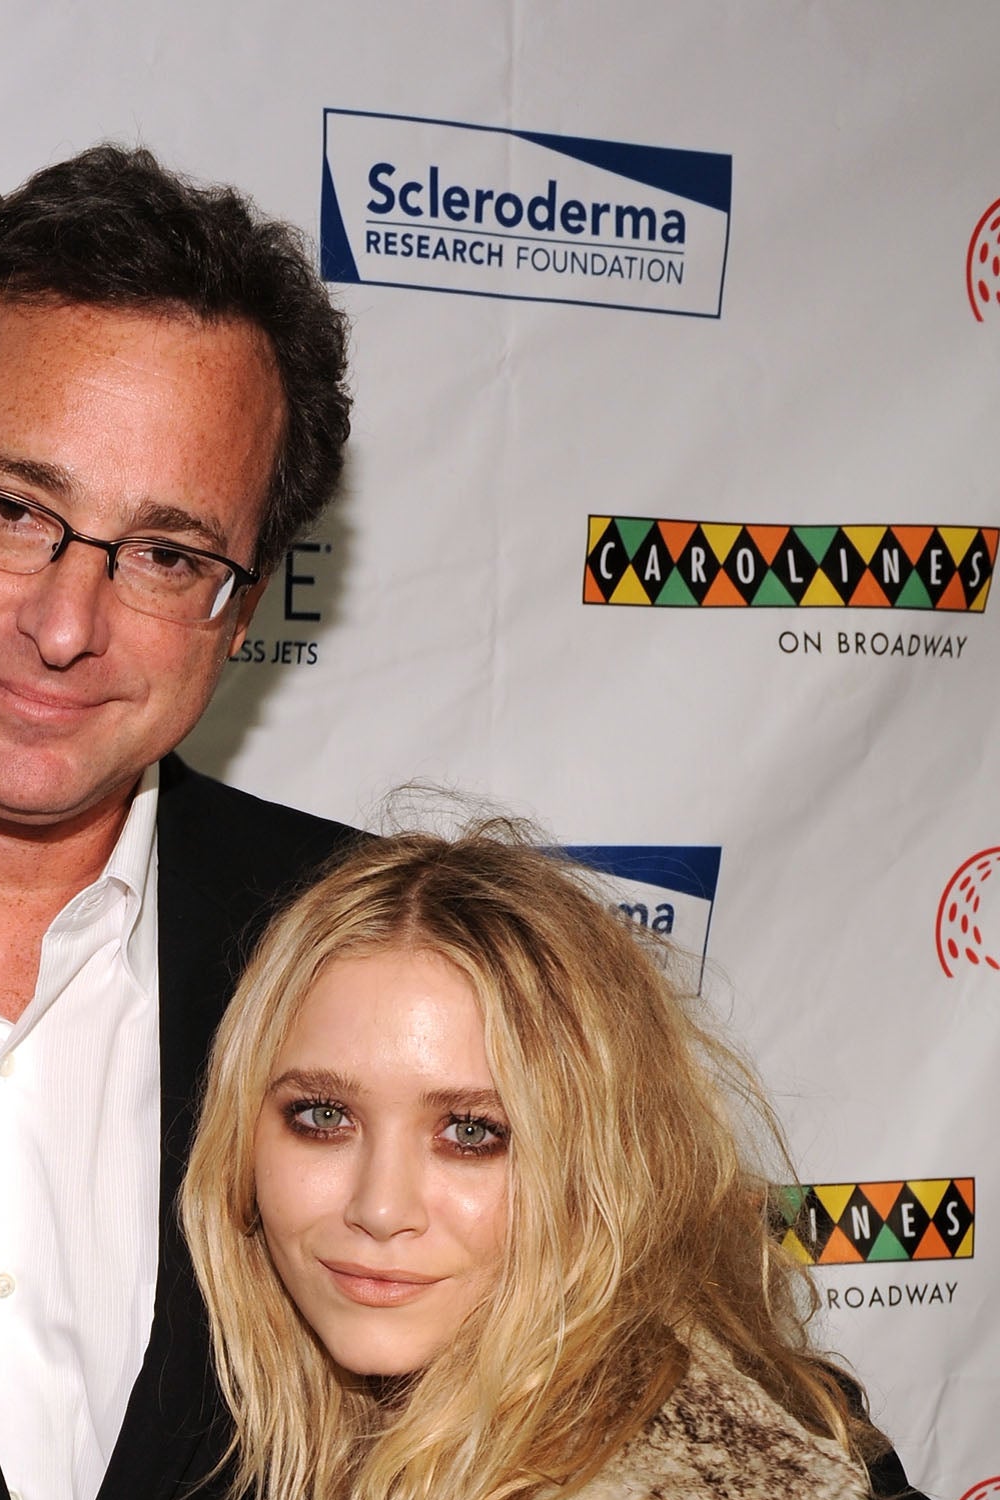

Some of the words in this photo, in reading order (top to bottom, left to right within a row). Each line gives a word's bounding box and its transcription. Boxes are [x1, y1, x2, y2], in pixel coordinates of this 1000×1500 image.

[367, 162, 686, 245] Scleroderma
[366, 230, 503, 268] RESEARCH
[517, 246, 685, 285] FOUNDATION
[600, 541, 983, 588] CAROLINES
[271, 640, 319, 665] JETS
[778, 631, 822, 655] ON
[838, 631, 968, 659] BROADWAY
[827, 1281, 958, 1310] ROADWAY
